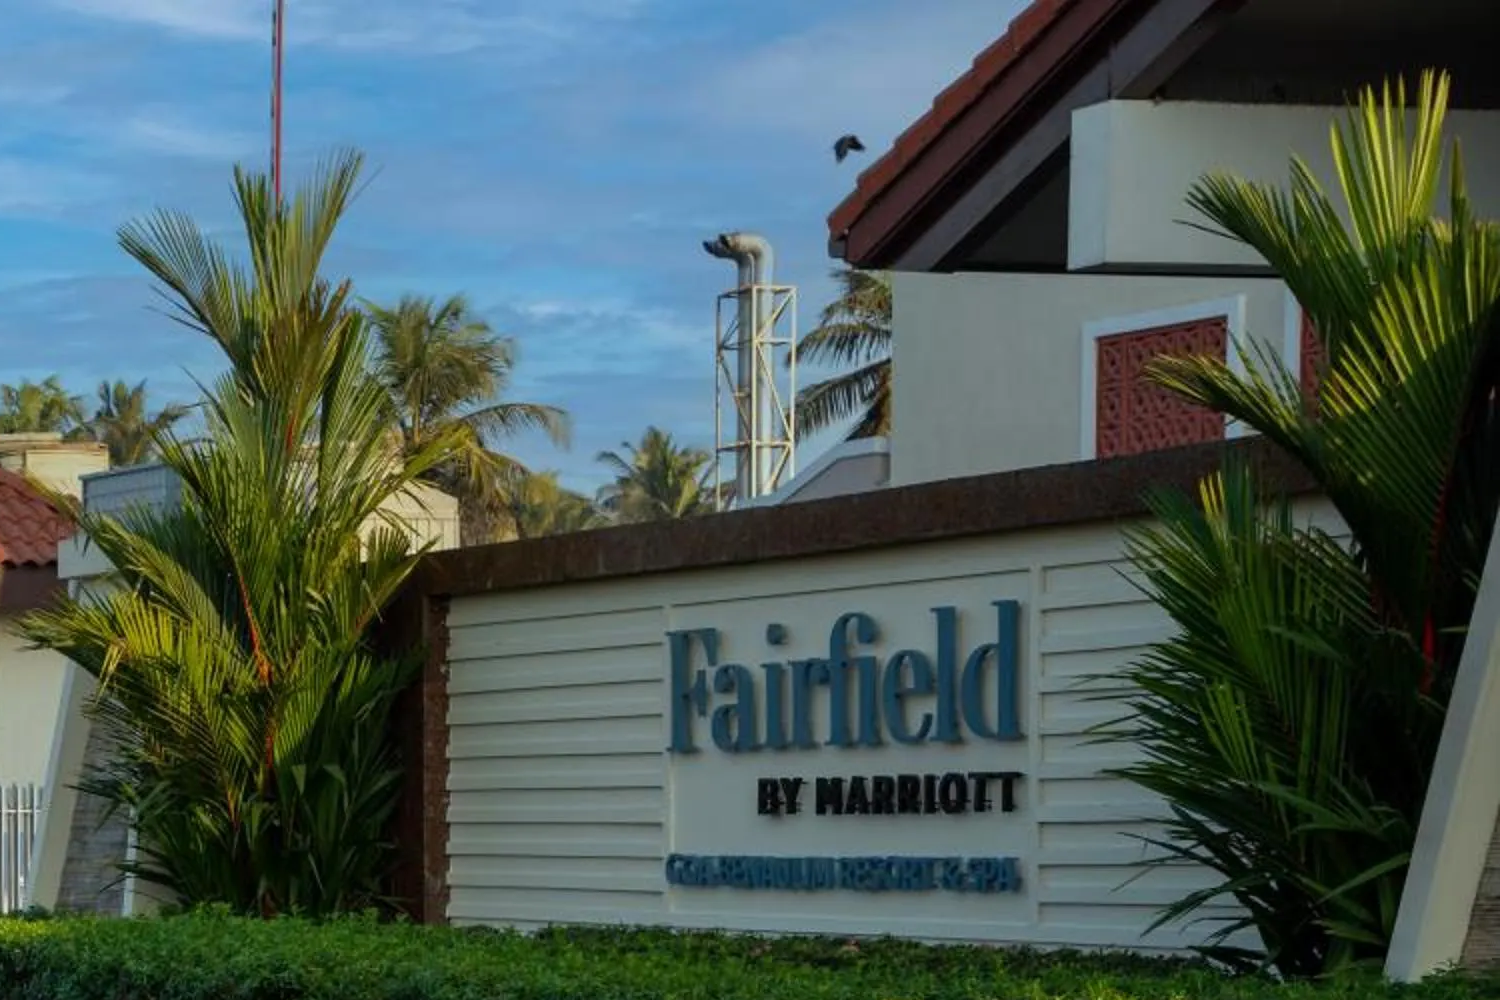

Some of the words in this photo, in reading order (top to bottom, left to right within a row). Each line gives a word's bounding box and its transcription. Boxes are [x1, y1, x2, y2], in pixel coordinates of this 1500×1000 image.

[665, 599, 1027, 755] Fairfield
[756, 776, 806, 816] BY
[815, 771, 1025, 816] MARRIOTT
